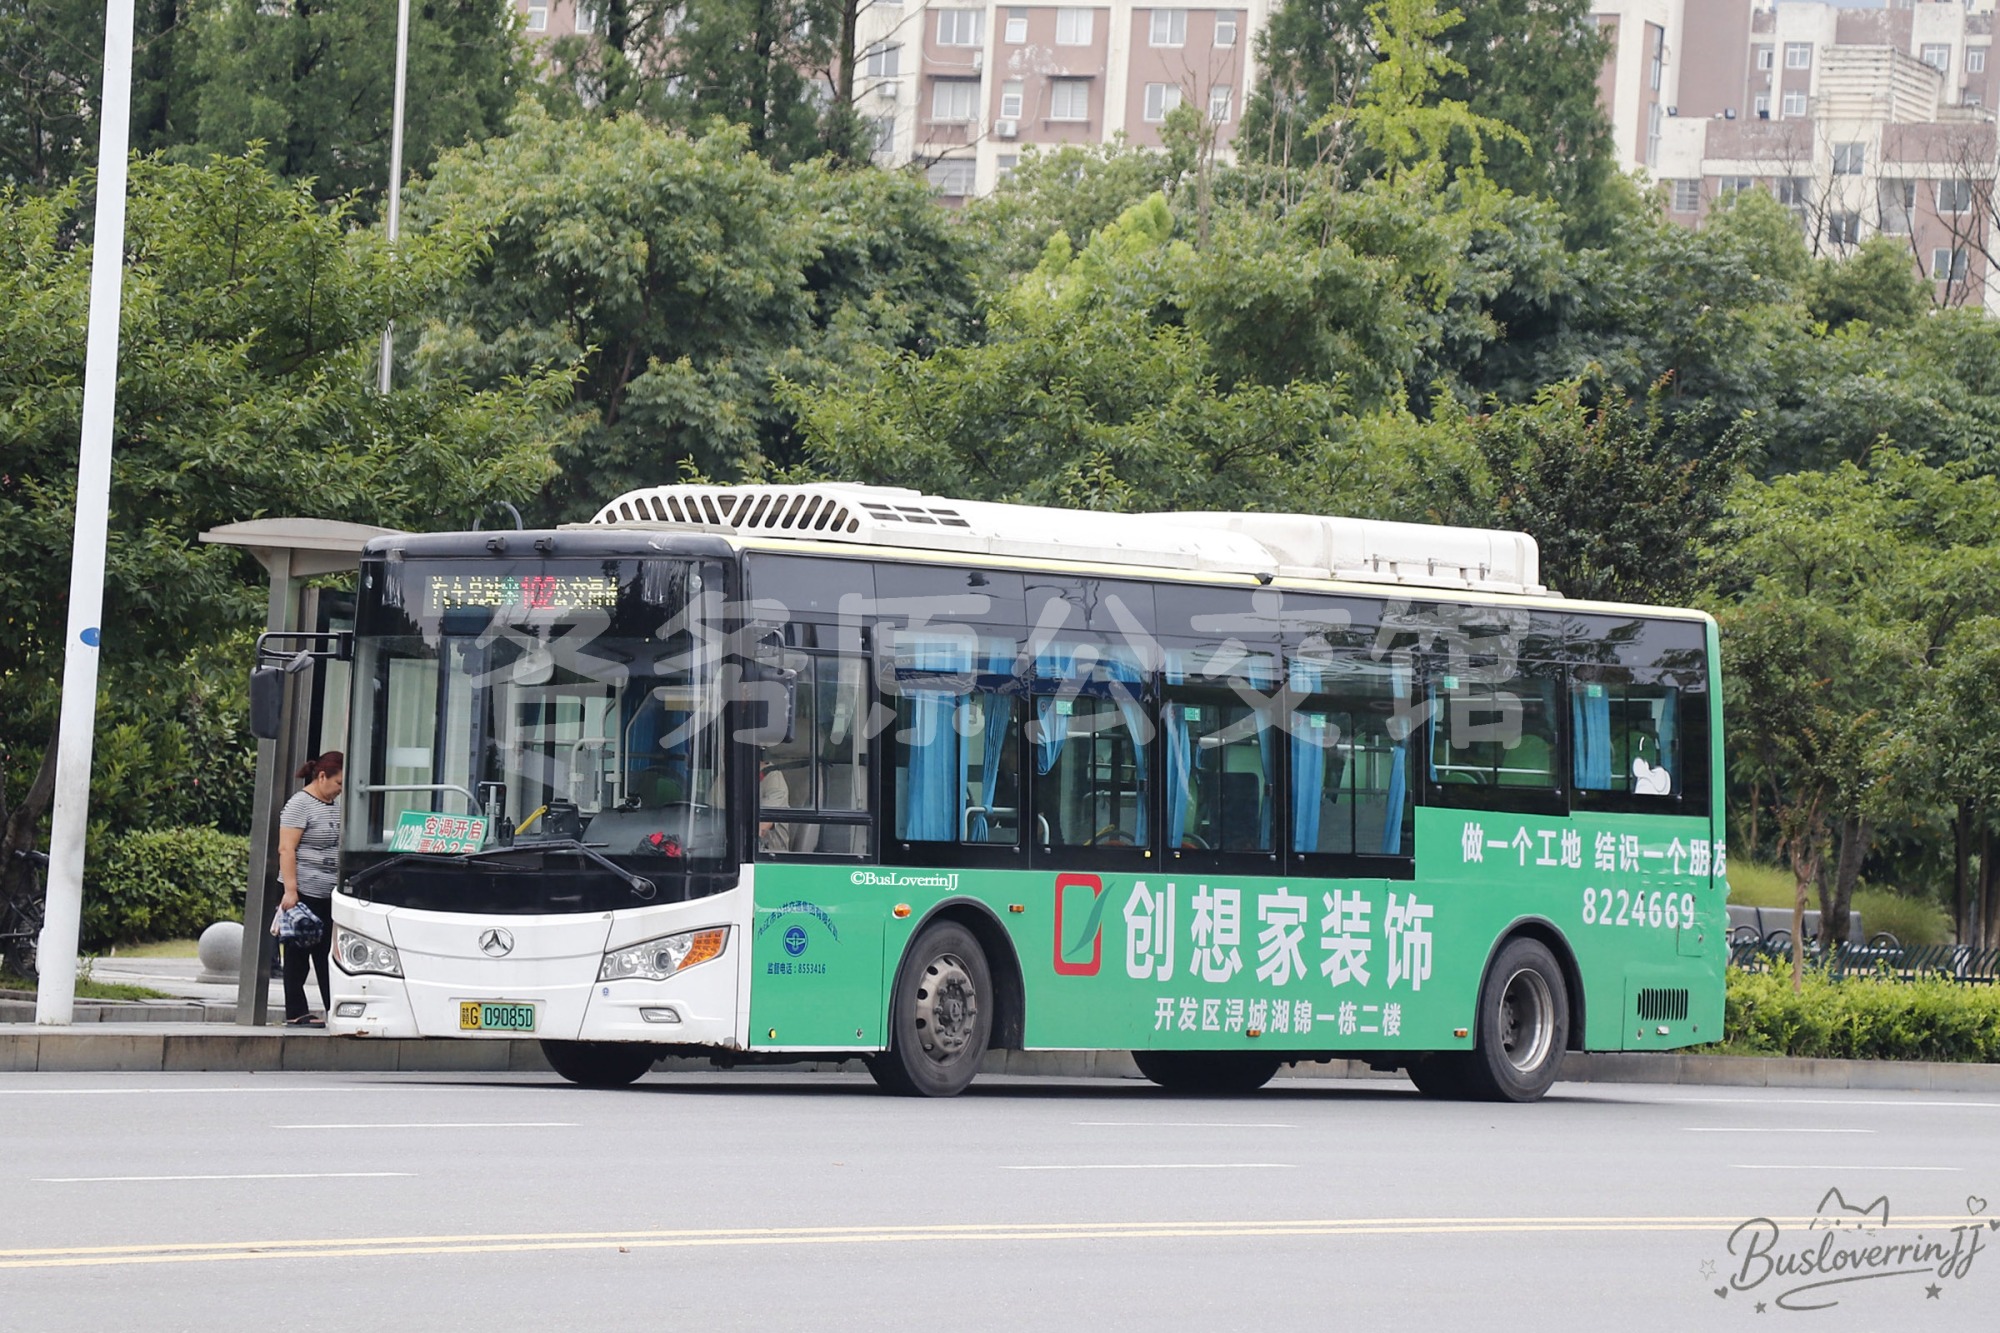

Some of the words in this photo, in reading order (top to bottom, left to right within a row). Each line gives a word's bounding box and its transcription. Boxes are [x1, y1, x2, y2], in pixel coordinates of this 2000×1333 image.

[520, 576, 556, 609] 102
[423, 816, 484, 841] 空调开启
[1461, 822, 1583, 870] 做一个工地
[1582, 887, 1695, 930] 8224669
[1122, 880, 1435, 992] 创想家装饰
[1154, 997, 1402, 1037] 开发区浔城湖锦一栋二楼
